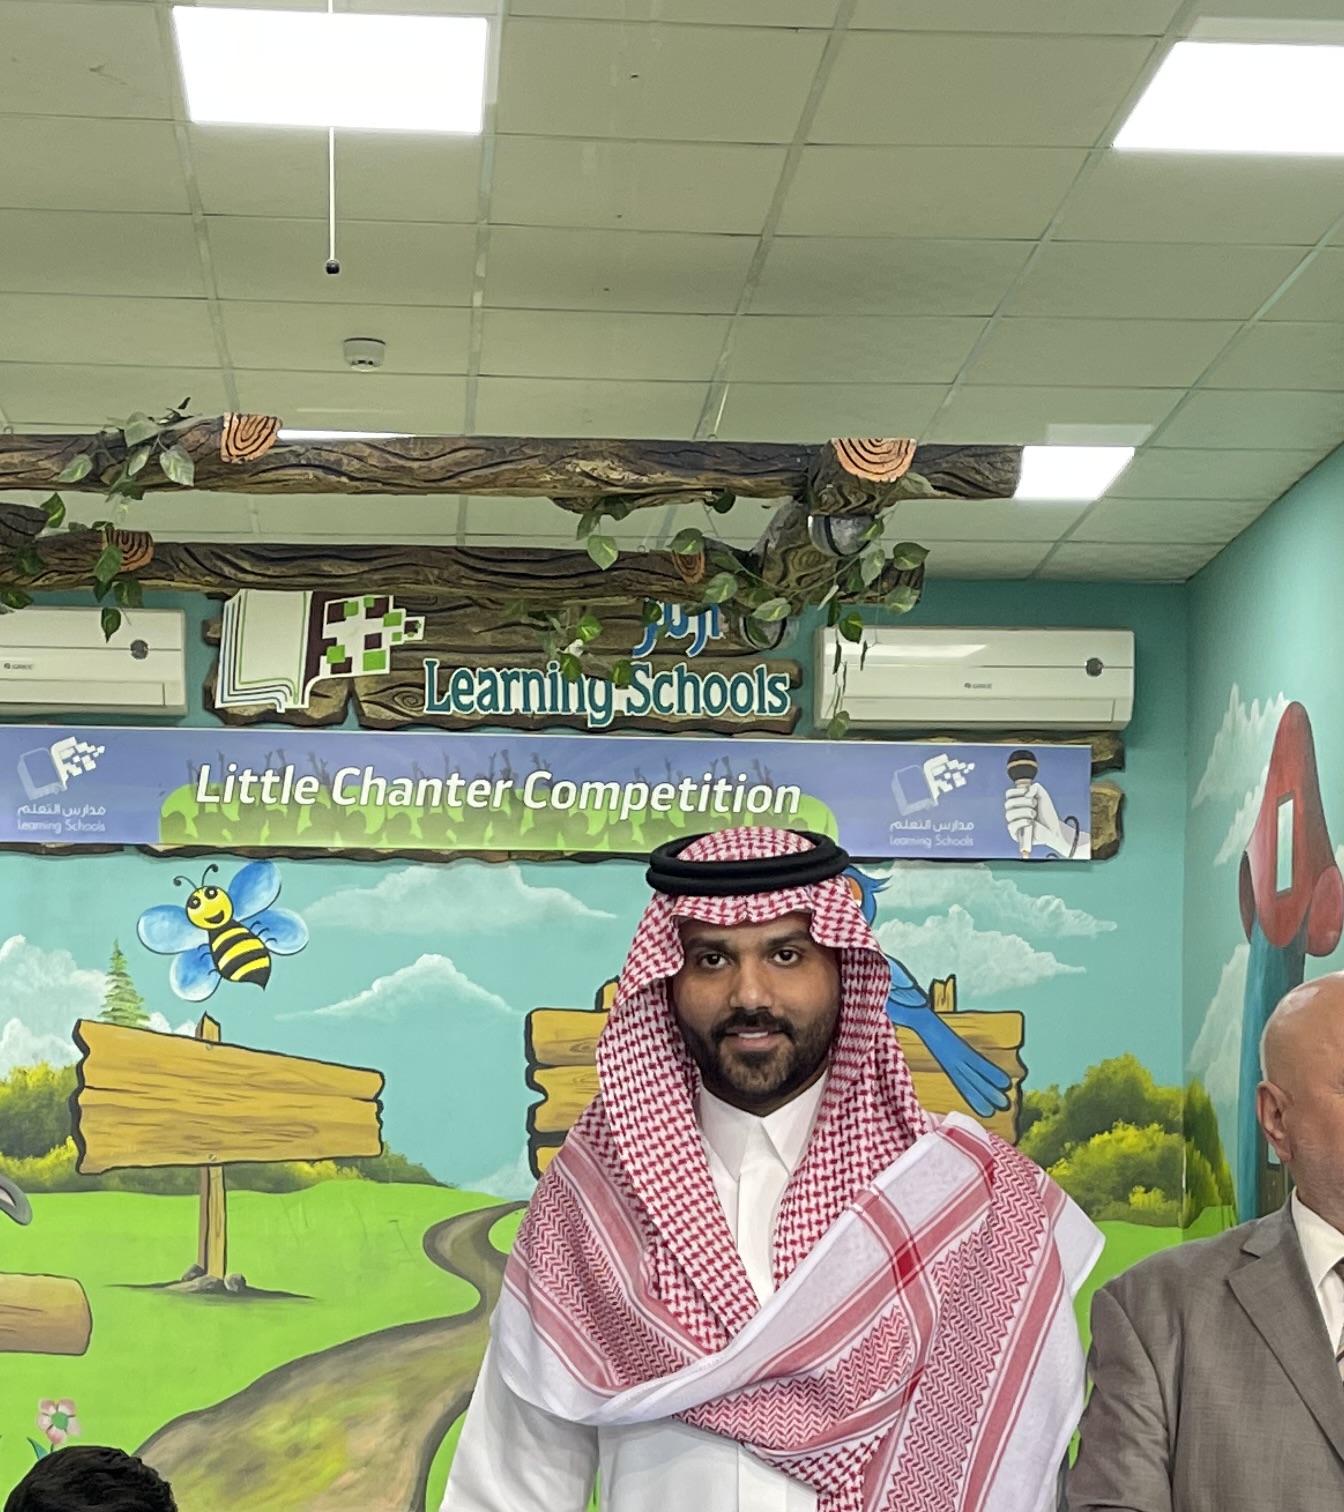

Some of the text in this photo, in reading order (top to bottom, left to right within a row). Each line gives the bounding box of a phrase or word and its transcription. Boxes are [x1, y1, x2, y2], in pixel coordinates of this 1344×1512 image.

[424, 657, 790, 727] Learning Schools
[195, 763, 801, 821] Little Chanter Competition
[17, 819, 106, 834] Learning Schools
[62, 804, 106, 817] مدارس
